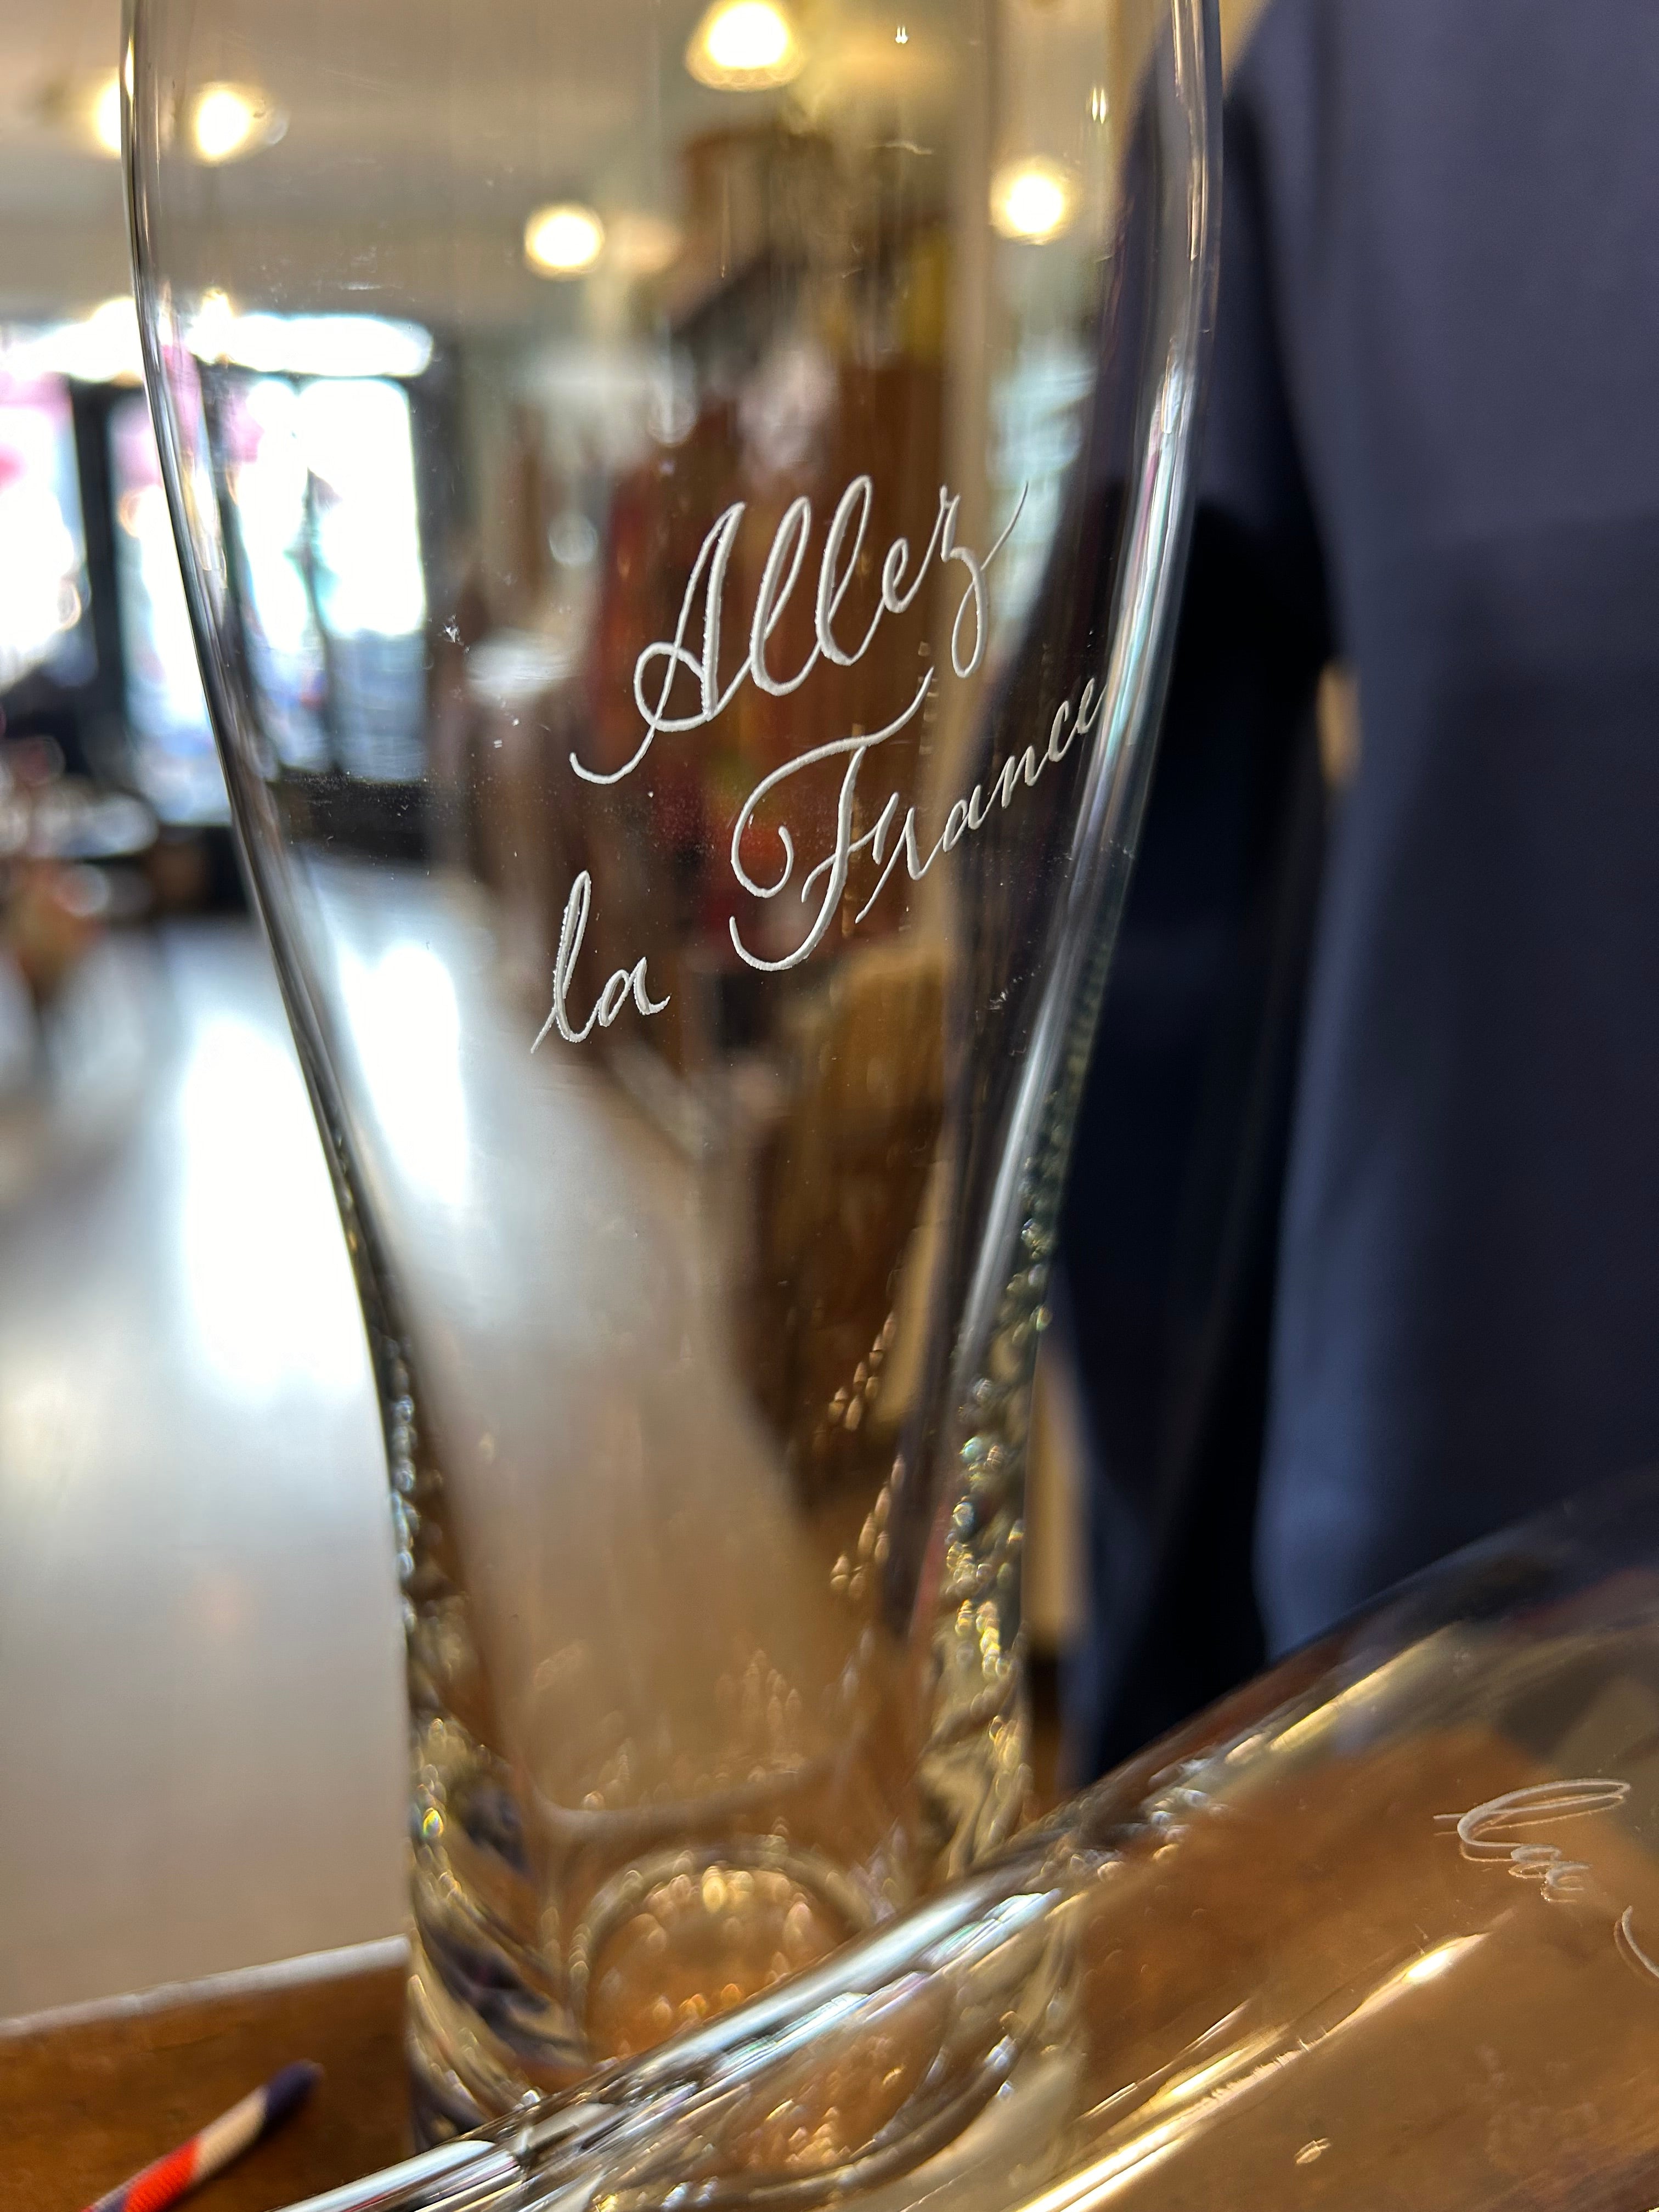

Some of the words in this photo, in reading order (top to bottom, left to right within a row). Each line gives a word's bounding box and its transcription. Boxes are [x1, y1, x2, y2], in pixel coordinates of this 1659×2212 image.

[570, 475, 1029, 783] Allez
[530, 870, 670, 1053] la
[730, 665, 1107, 971] France
